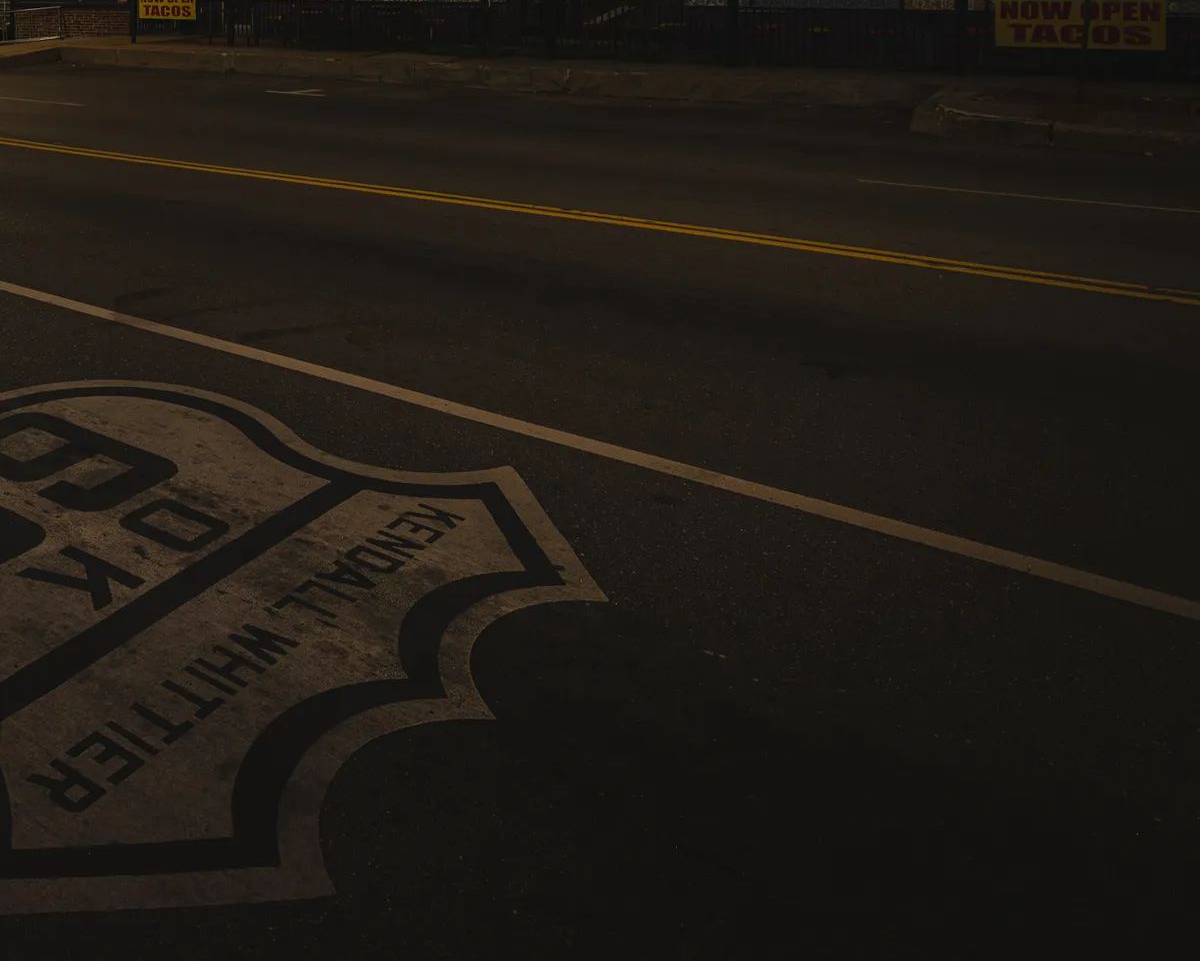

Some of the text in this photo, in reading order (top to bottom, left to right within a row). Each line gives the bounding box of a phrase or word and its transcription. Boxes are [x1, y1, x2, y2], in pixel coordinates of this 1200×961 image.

[144, 5, 191, 17] TACOS
[1001, 1, 1161, 21] NOW OPEN
[1008, 24, 1153, 45] TACOS
[25, 623, 300, 813] WHITTIER
